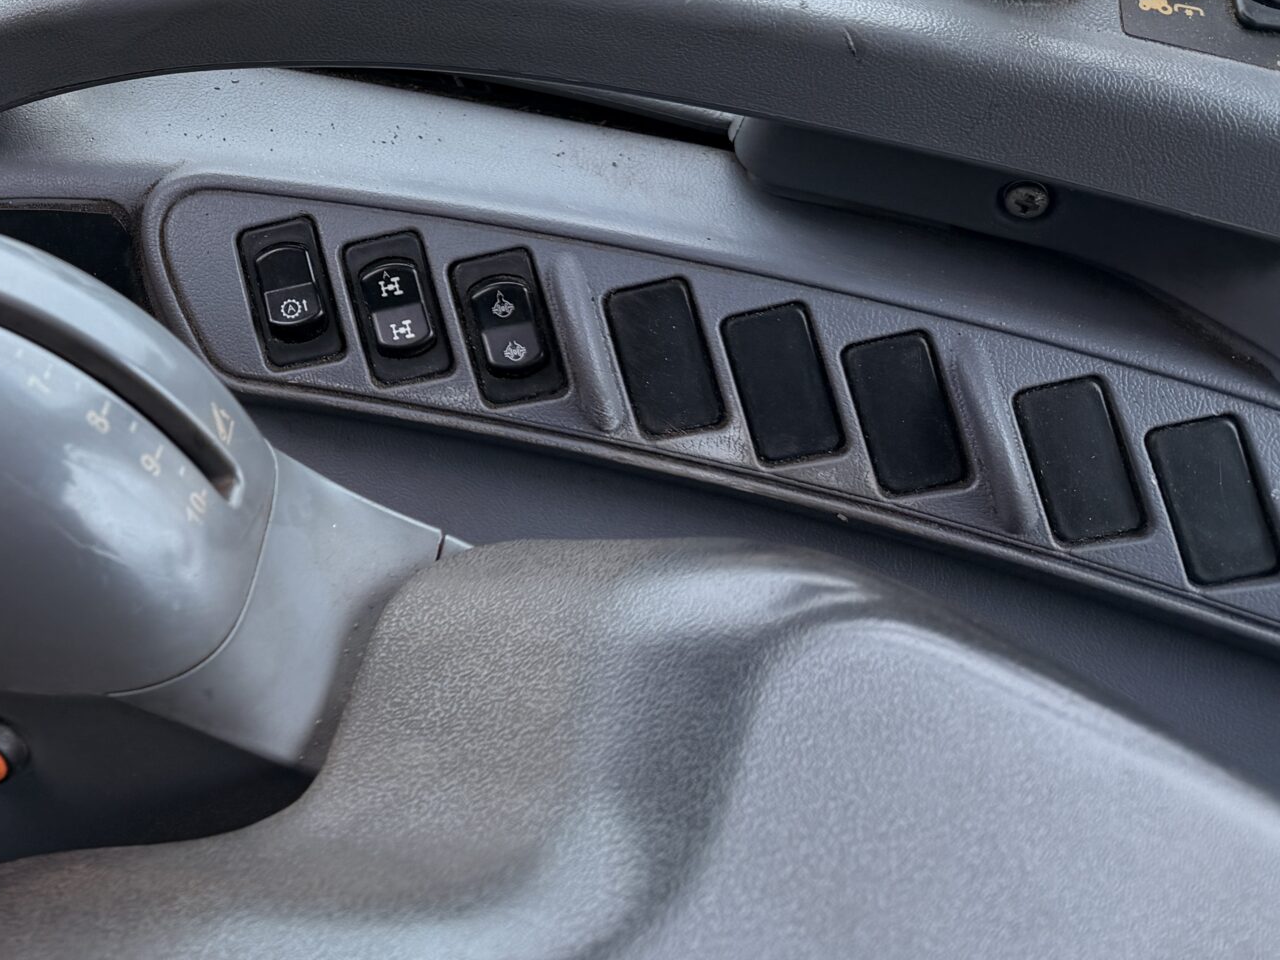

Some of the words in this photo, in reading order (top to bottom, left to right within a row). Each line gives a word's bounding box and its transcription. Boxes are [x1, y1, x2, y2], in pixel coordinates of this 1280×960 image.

[85, 409, 111, 434] 8
[140, 453, 161, 477] 9
[185, 491, 208, 522] 10
